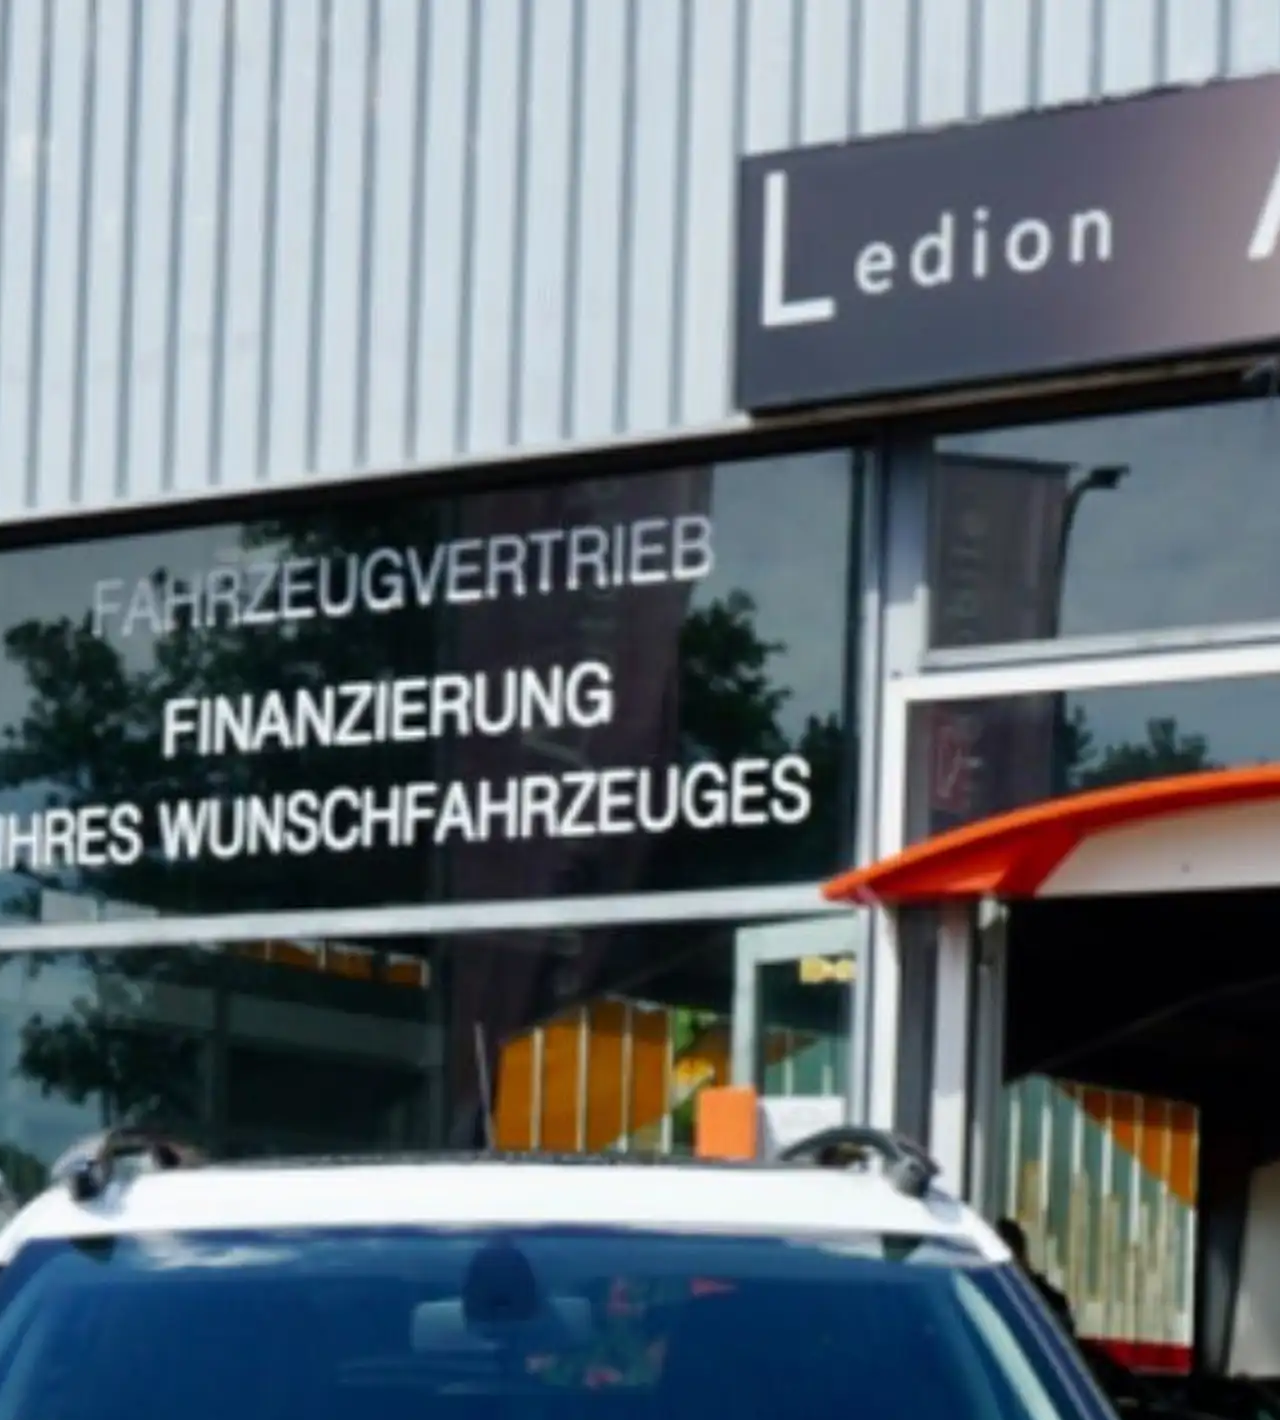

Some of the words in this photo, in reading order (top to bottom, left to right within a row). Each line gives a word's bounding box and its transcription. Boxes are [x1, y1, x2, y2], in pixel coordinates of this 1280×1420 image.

[760, 170, 1114, 328] Ledion
[91, 514, 720, 640] FAHRZEUGVERTRIEB
[161, 660, 615, 758] FINANZIERUNG
[158, 754, 813, 862] WUNSCHFAHRZEUGES
